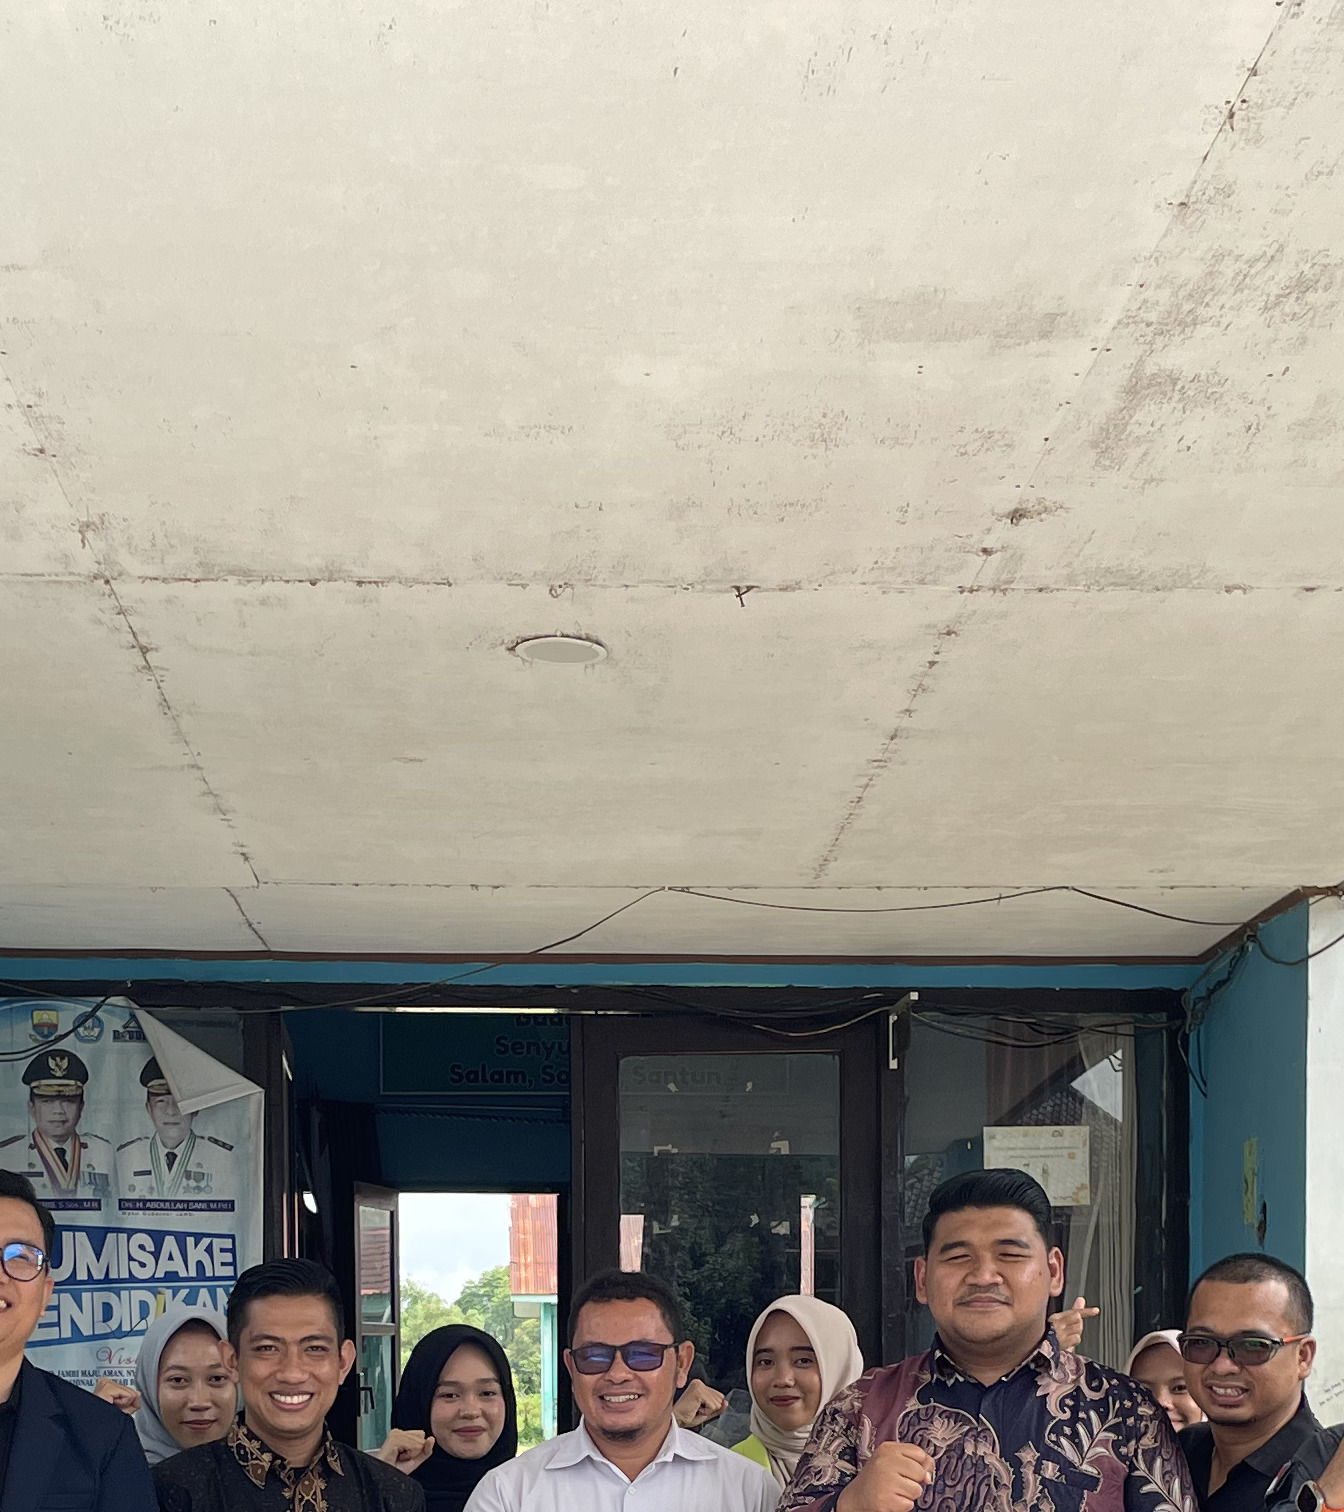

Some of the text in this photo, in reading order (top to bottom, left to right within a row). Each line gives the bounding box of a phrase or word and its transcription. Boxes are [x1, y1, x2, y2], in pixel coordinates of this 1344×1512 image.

[494, 1035, 571, 1061] Senyu
[449, 1063, 535, 1089] Salam,
[49, 1231, 235, 1283] UMISAKE
[96, 1346, 137, 1365] Vis
